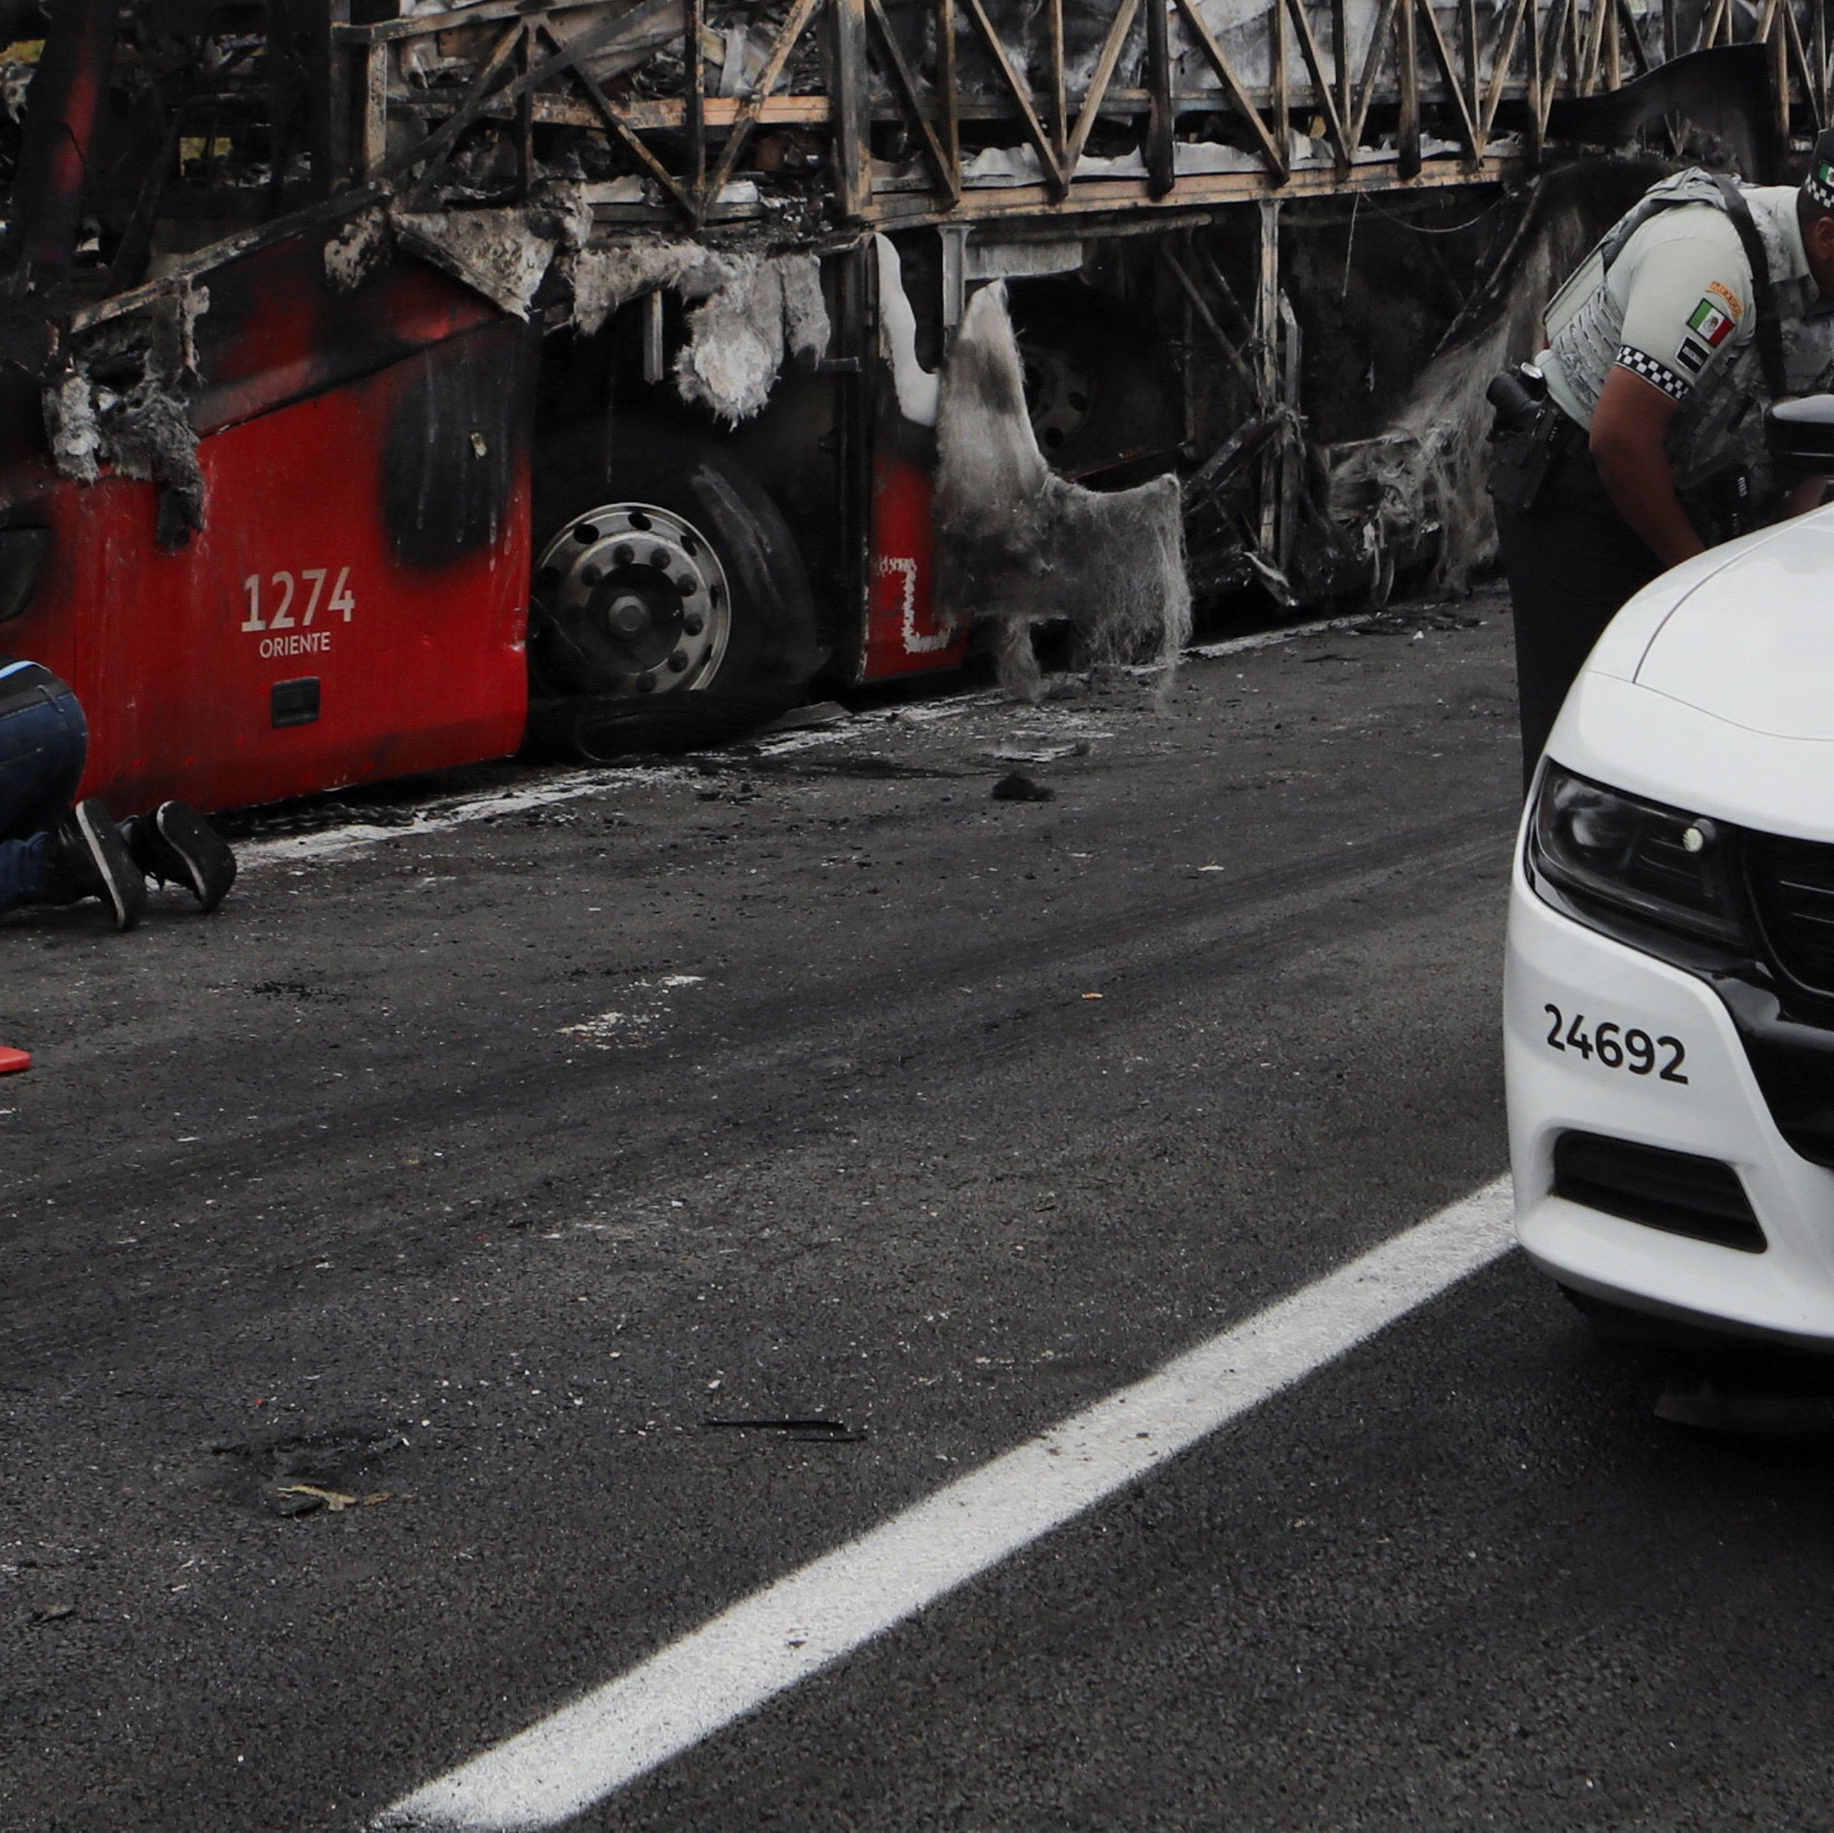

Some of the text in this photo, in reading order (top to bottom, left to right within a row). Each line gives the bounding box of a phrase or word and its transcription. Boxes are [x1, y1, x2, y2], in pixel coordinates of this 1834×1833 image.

[241, 566, 356, 633] 1274
[259, 631, 331, 659] ORIENTE
[1544, 1003, 1689, 1085] 24692
